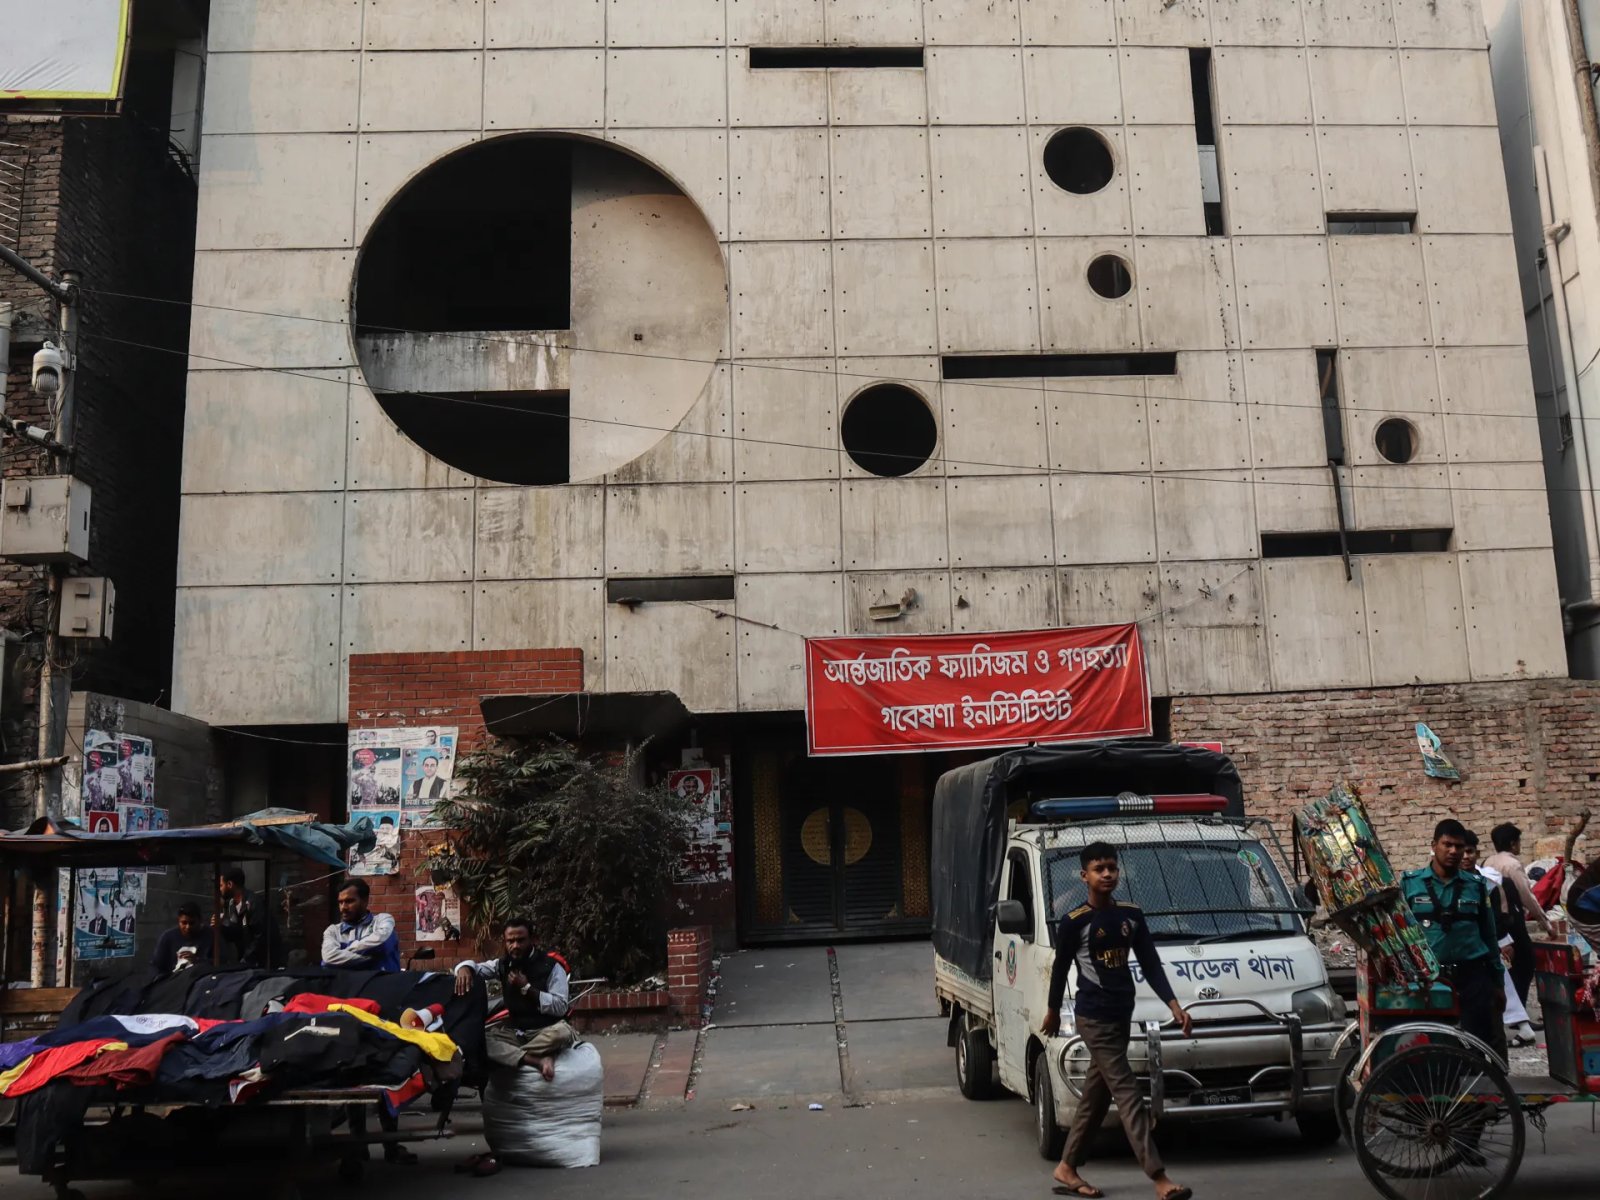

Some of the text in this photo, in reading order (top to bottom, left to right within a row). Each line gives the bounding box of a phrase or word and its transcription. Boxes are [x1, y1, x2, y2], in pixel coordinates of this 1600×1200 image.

[937, 642, 1029, 679] ফ্যাসিজম
[1034, 650, 1050, 674] ও
[1058, 643, 1128, 672] গণহত্যা
[881, 689, 1073, 731] গবেষণা ইনস্টিটিউট
[1171, 958, 1240, 981] মডেল
[1248, 955, 1295, 981] থানা
